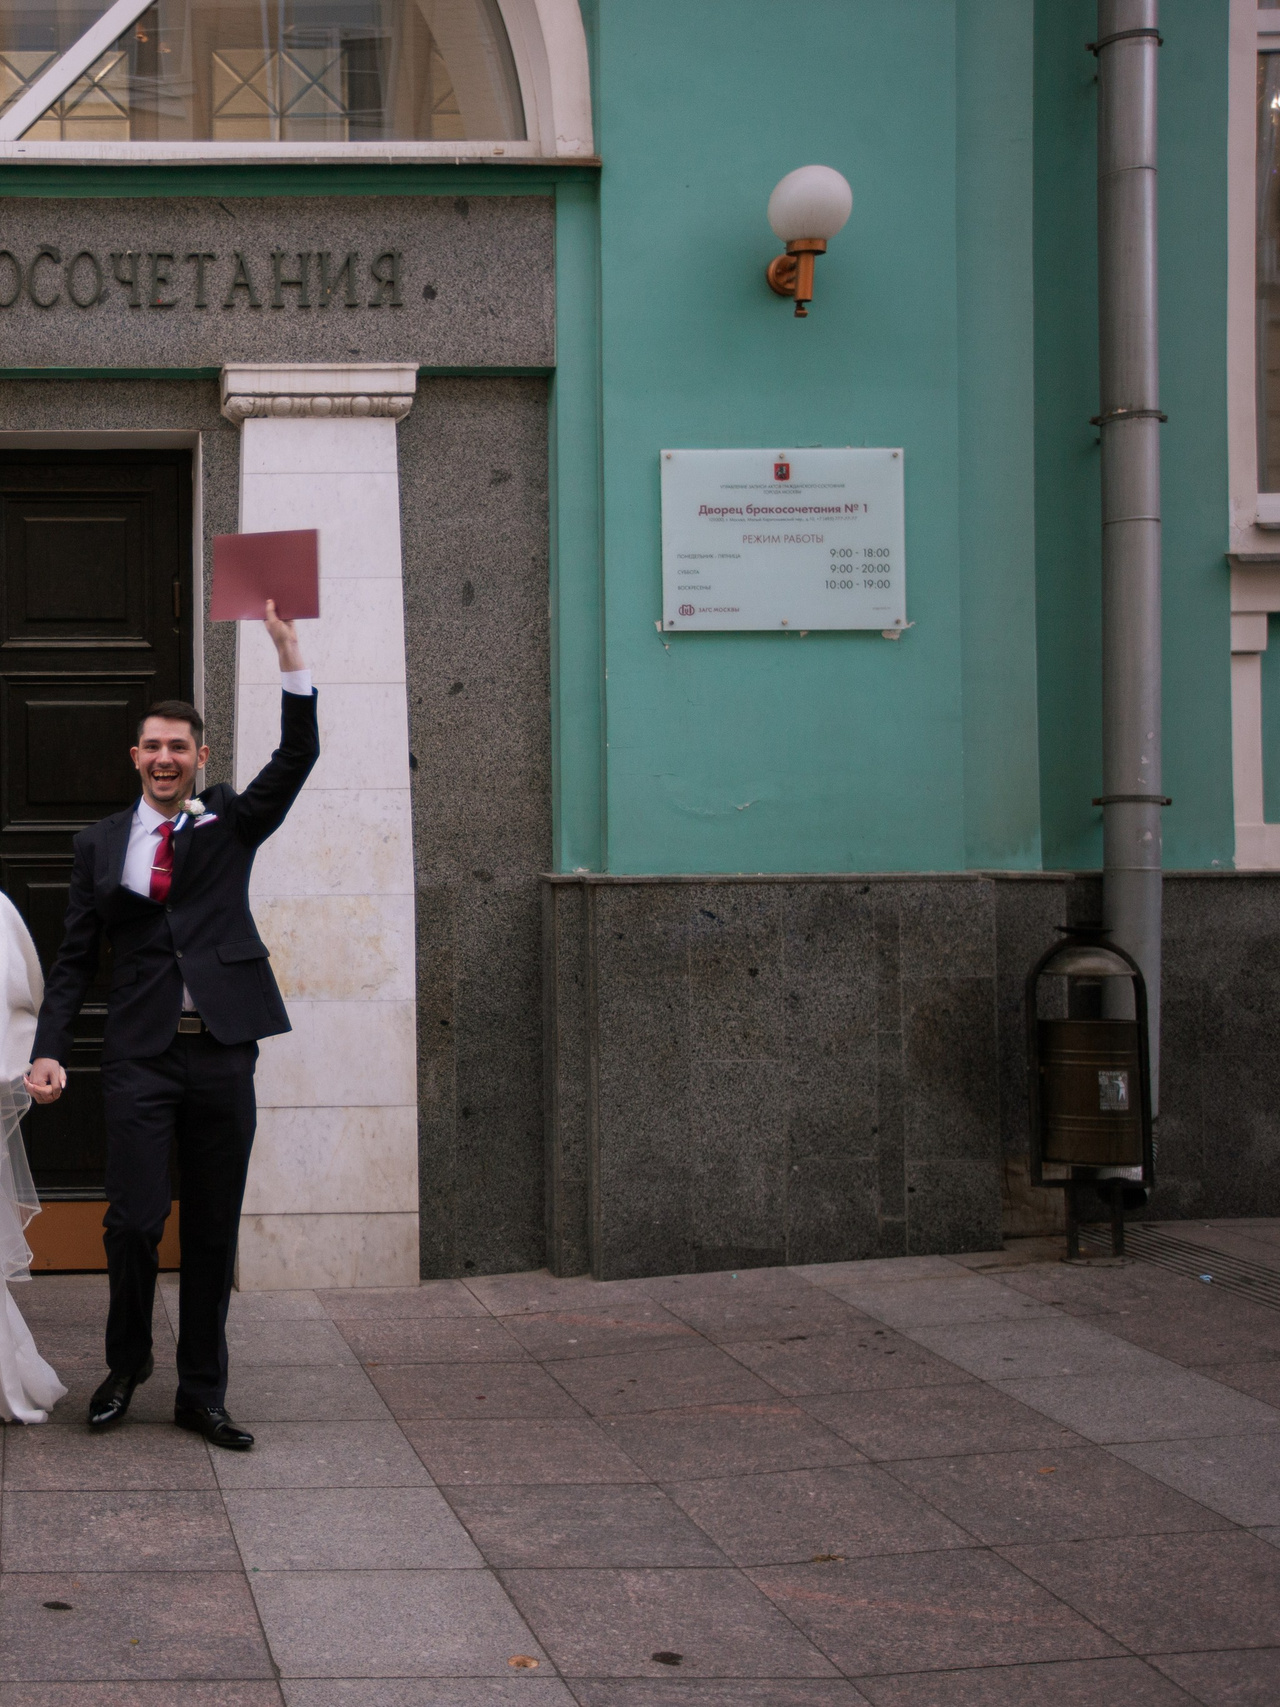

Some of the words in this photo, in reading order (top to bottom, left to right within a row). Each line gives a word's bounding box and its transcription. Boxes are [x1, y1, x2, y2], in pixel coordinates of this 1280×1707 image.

[698, 505, 743, 516] Дворец
[746, 504, 841, 516] бракосочетания
[844, 503, 859, 513] №
[863, 503, 868, 513] 1
[742, 535, 781, 544] РЕЖИМ
[783, 534, 824, 543] РАБОТЫ
[829, 548, 853, 558] 9:00
[863, 548, 890, 558] 18:00
[830, 563, 853, 573] 9:00
[861, 563, 890, 573] 20:00
[825, 579, 853, 589] 10:00
[863, 579, 890, 589] 19:00
